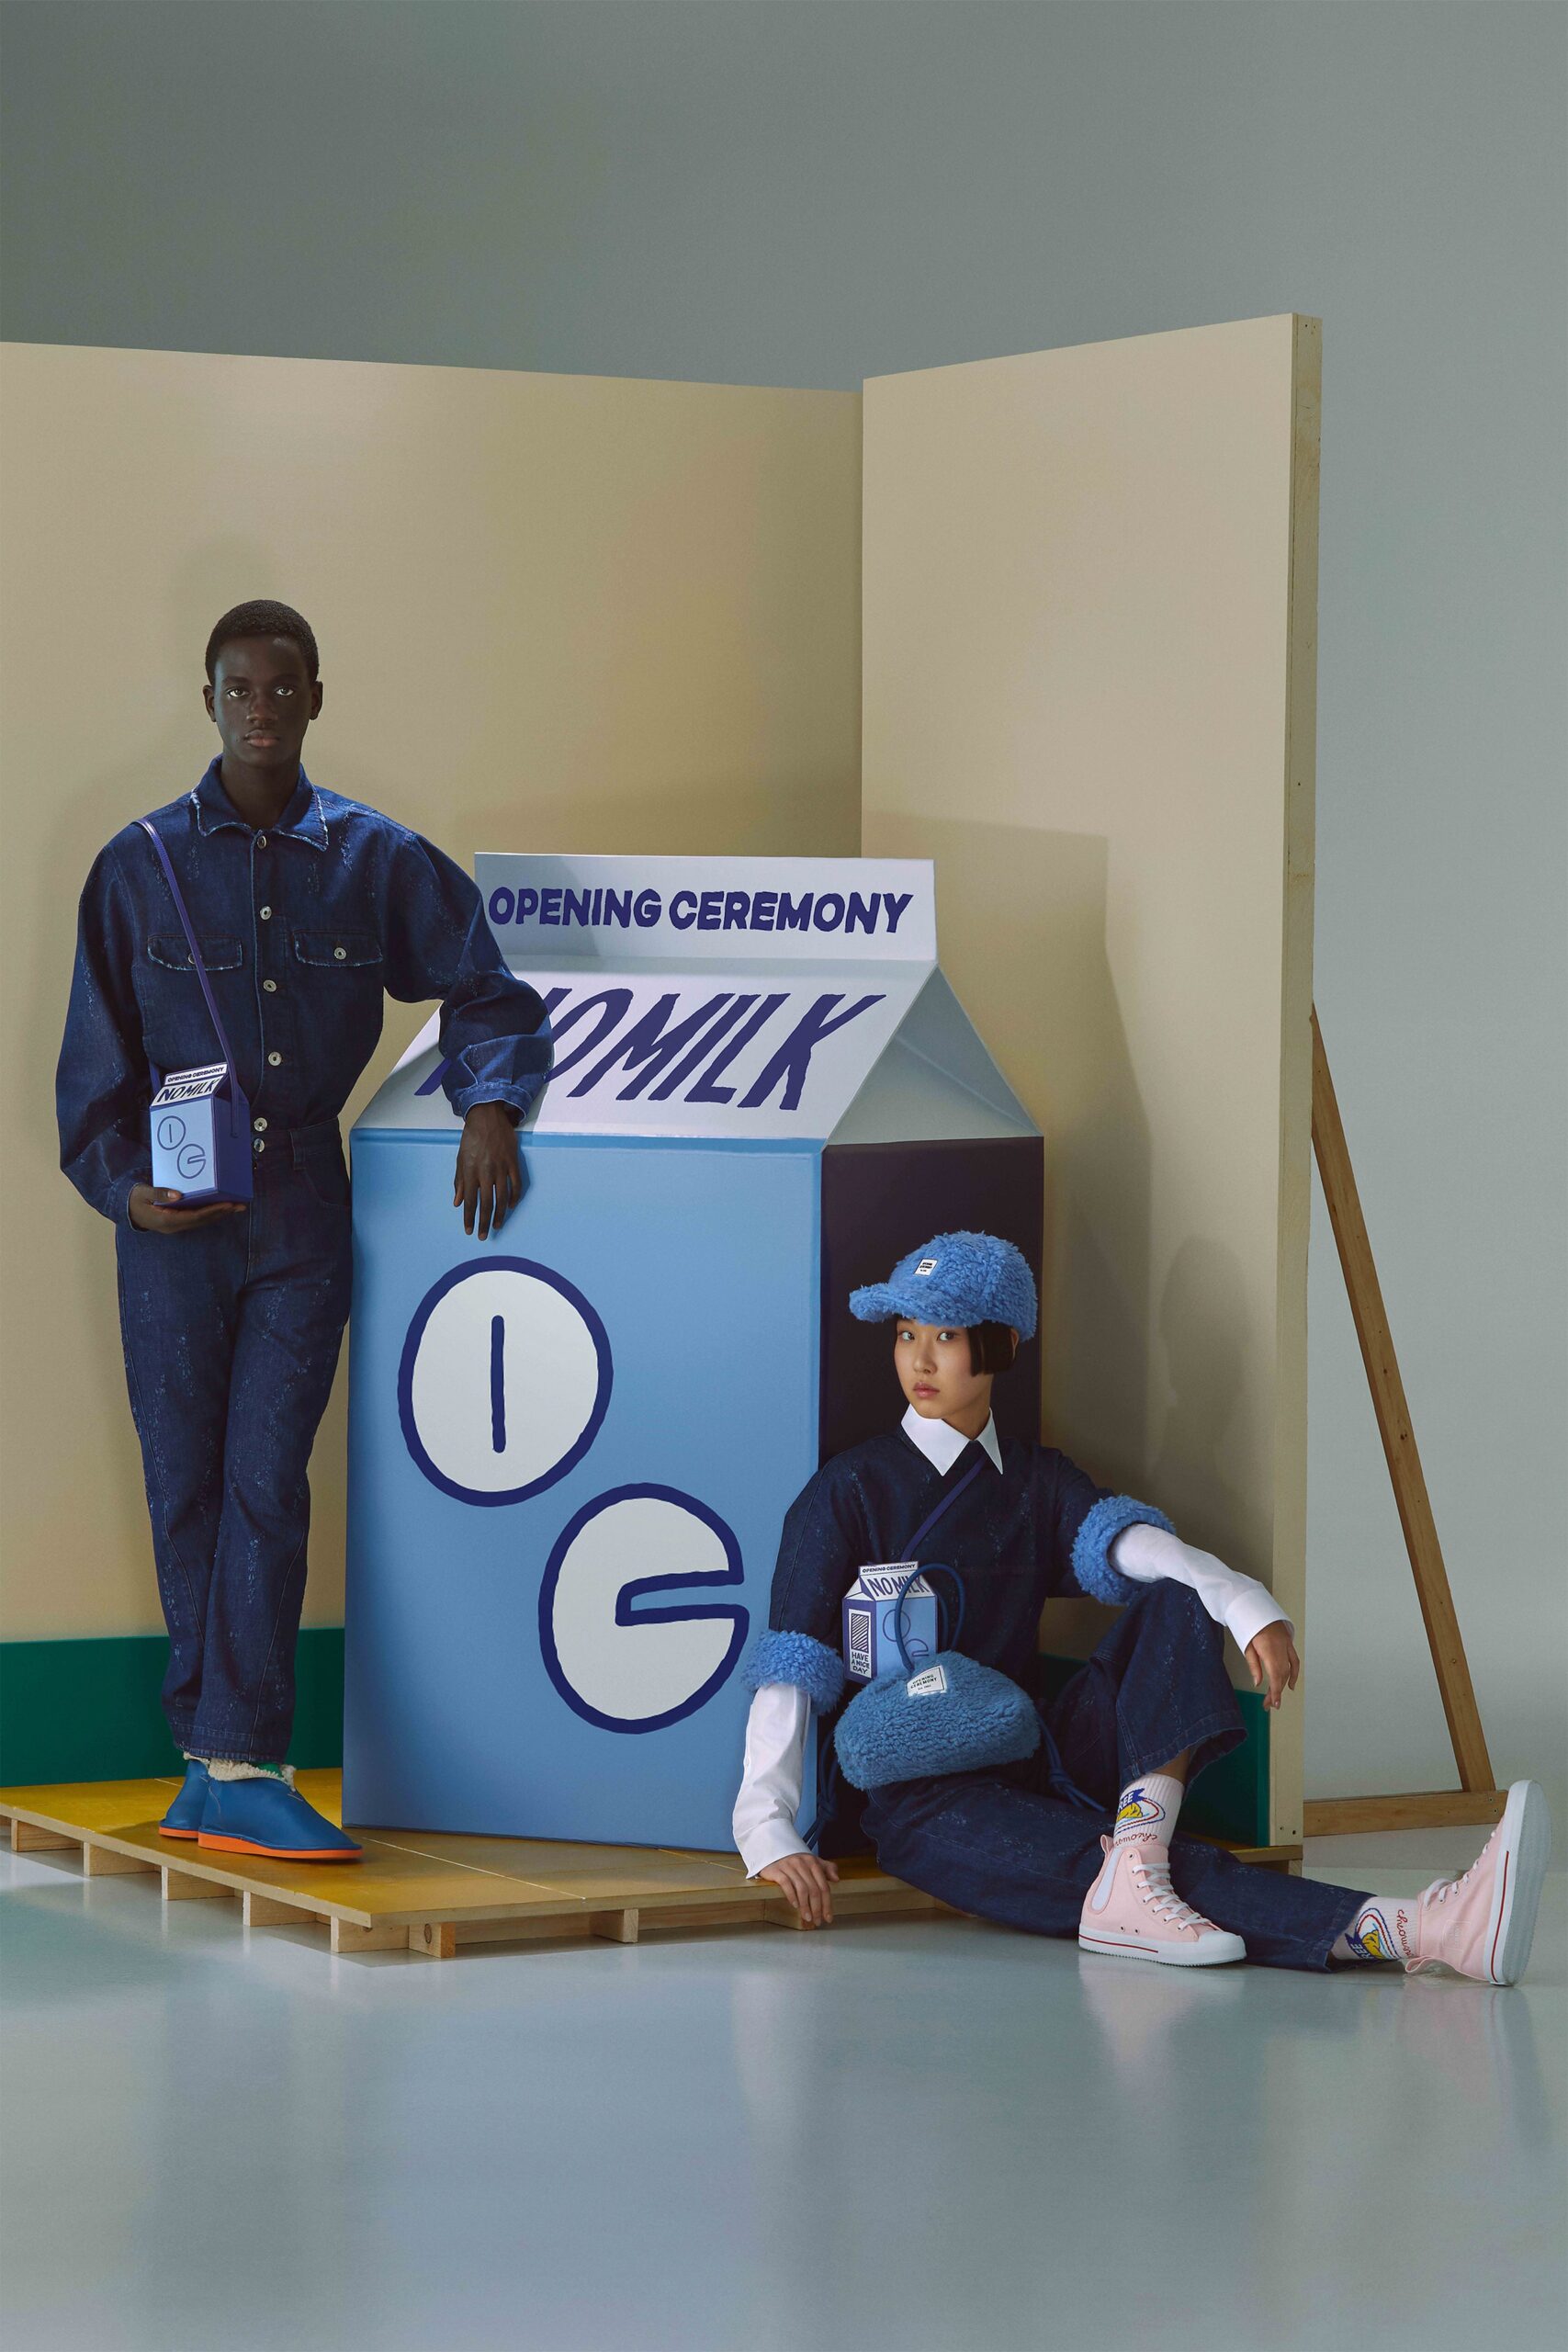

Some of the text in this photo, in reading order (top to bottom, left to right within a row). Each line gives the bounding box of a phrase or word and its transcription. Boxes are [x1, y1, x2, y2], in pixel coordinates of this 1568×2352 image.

[488, 887, 913, 934] OPENING CEREMONY
[414, 987, 886, 1111] OMILK
[167, 1067, 224, 1082] OPENING CEREMONY
[852, 1651, 869, 1662] HAVE
[853, 1665, 868, 1674] DAY
[855, 1660, 870, 1669] NICE
